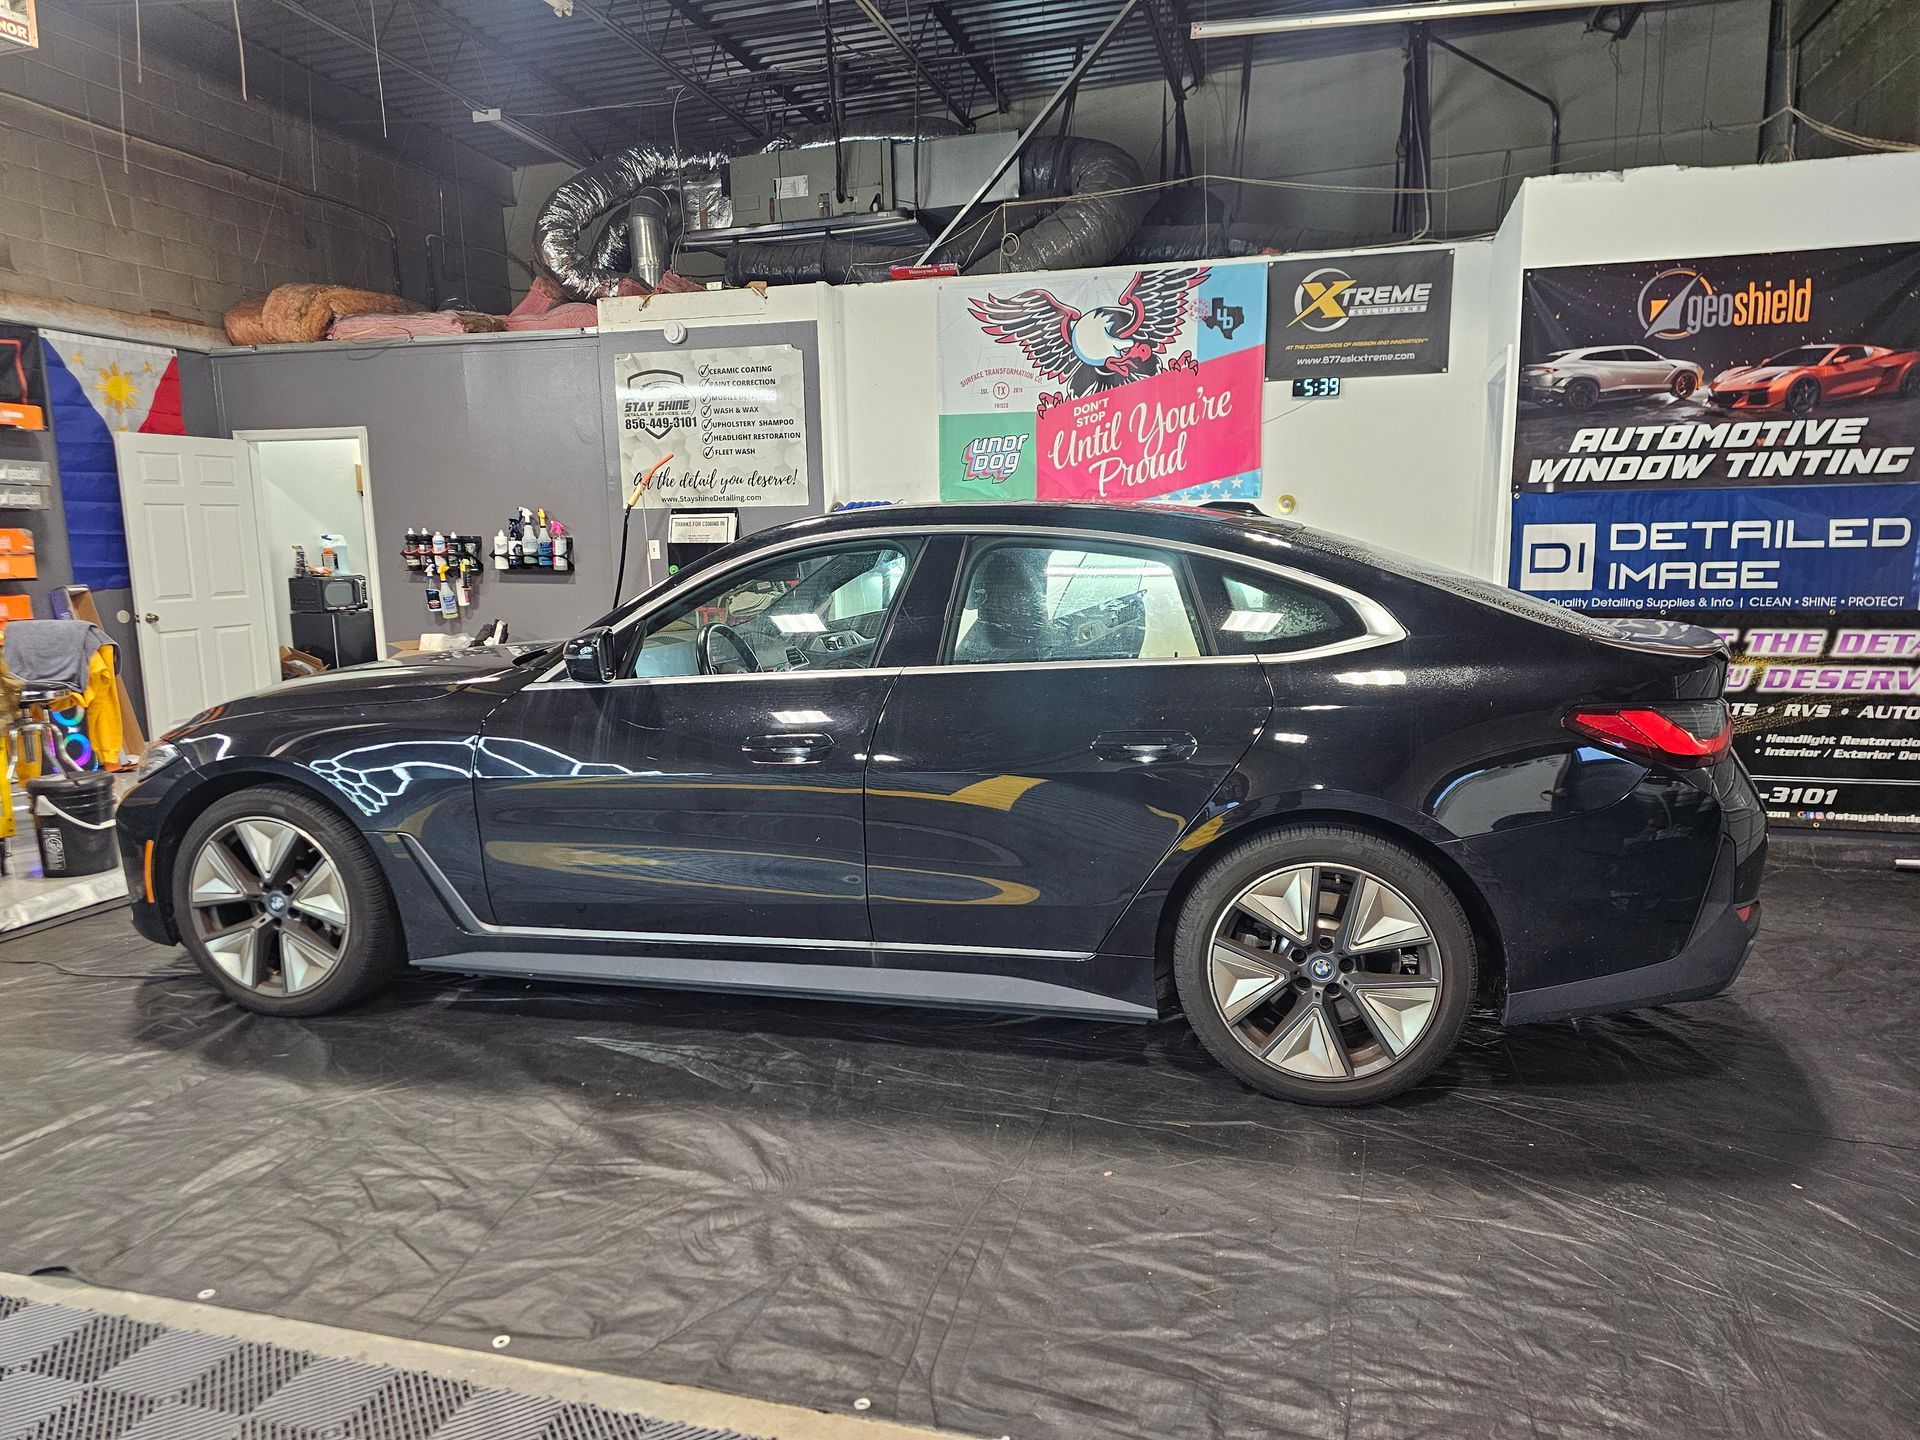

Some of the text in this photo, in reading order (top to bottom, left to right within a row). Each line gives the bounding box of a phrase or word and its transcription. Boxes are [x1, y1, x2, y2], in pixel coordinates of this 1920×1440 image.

[1354, 306, 1421, 315] SOLUTIONS
[1687, 277, 1812, 335] geoshield
[1305, 342, 1342, 350] CROSSROADS
[1296, 352, 1416, 366] www.877askxtreme.com
[709, 366, 772, 375] CERAMIC COATING
[960, 367, 1043, 388] SURFACE TRANSFORMATION CO.
[732, 378, 776, 386] CORRECTION
[1303, 377, 1340, 397] 5:39
[996, 386, 1006, 396] TX
[624, 400, 690, 413] STAY SHINE
[713, 407, 734, 415] WASH
[1073, 398, 1110, 417] DON'T
[625, 416, 697, 430] 856-449-3101
[712, 418, 794, 428] UPHOLSTERY SHAMPOO
[1076, 411, 1106, 428] STOP
[1048, 386, 1232, 470] Until You're
[1568, 417, 1870, 453] AUTOMOTIVE
[713, 432, 801, 442] HEADLIGHT RESTORATION
[714, 448, 756, 456] FLEET WASH
[1088, 431, 1188, 497] Proud
[1528, 446, 1916, 484] WINDOW TINTING
[656, 466, 676, 490] the
[680, 468, 718, 490] detail
[720, 473, 744, 494] you
[748, 468, 798, 488] deserve!
[661, 494, 762, 504] www.StayshineDetailing.com
[692, 520, 702, 528] FOR
[1610, 517, 1912, 551] DETAILED
[1608, 560, 1780, 591] IMAGE
[1548, 597, 1588, 610] Quality
[1591, 597, 1644, 610] Detailing
[1646, 597, 1696, 610] Supplies
[1698, 597, 1708, 608] &
[1711, 596, 1734, 608] Info
[1749, 596, 1792, 608] CLEAN
[1801, 596, 1838, 608] SHINE
[1848, 596, 1904, 608] PROTECT
[1751, 632, 1824, 654] THE
[1838, 633, 1920, 654] DET
[1784, 704, 1832, 718] RVS
[1857, 705, 1920, 720] AUTO
[1765, 734, 1920, 747] Headlight Restoratio
[1764, 746, 1822, 758] Interior
[1833, 748, 1896, 760] Exterior
[1759, 786, 1838, 805] -3101
